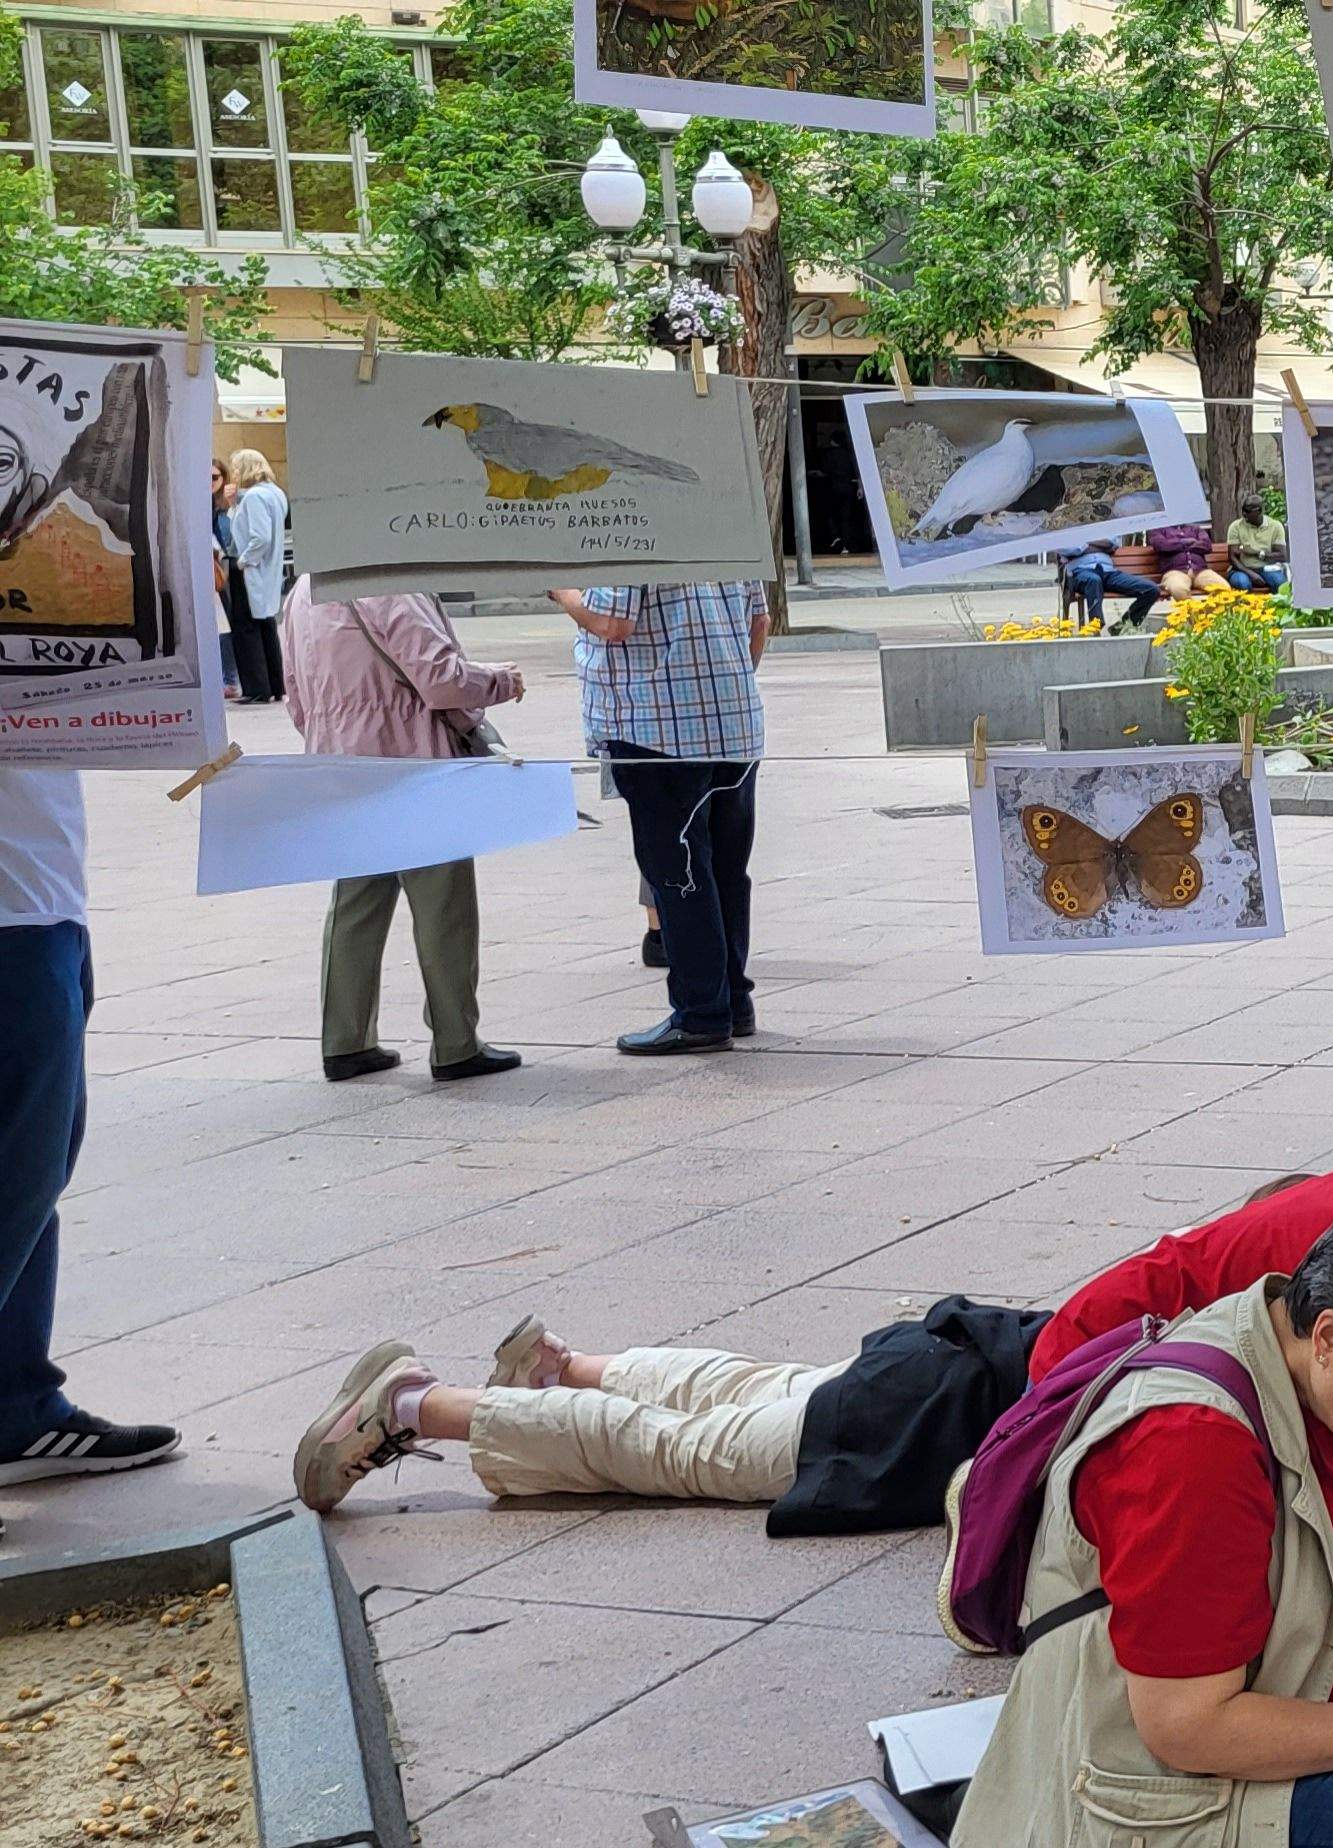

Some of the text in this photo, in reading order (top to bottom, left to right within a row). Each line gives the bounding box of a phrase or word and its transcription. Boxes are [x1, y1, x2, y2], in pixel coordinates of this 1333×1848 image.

[28, 637, 127, 667] ROYA
[83, 680, 103, 691] 25
[108, 678, 123, 688] de
[128, 672, 174, 684] marzo
[1, 708, 193, 734] ¡Ven a dibujar!
